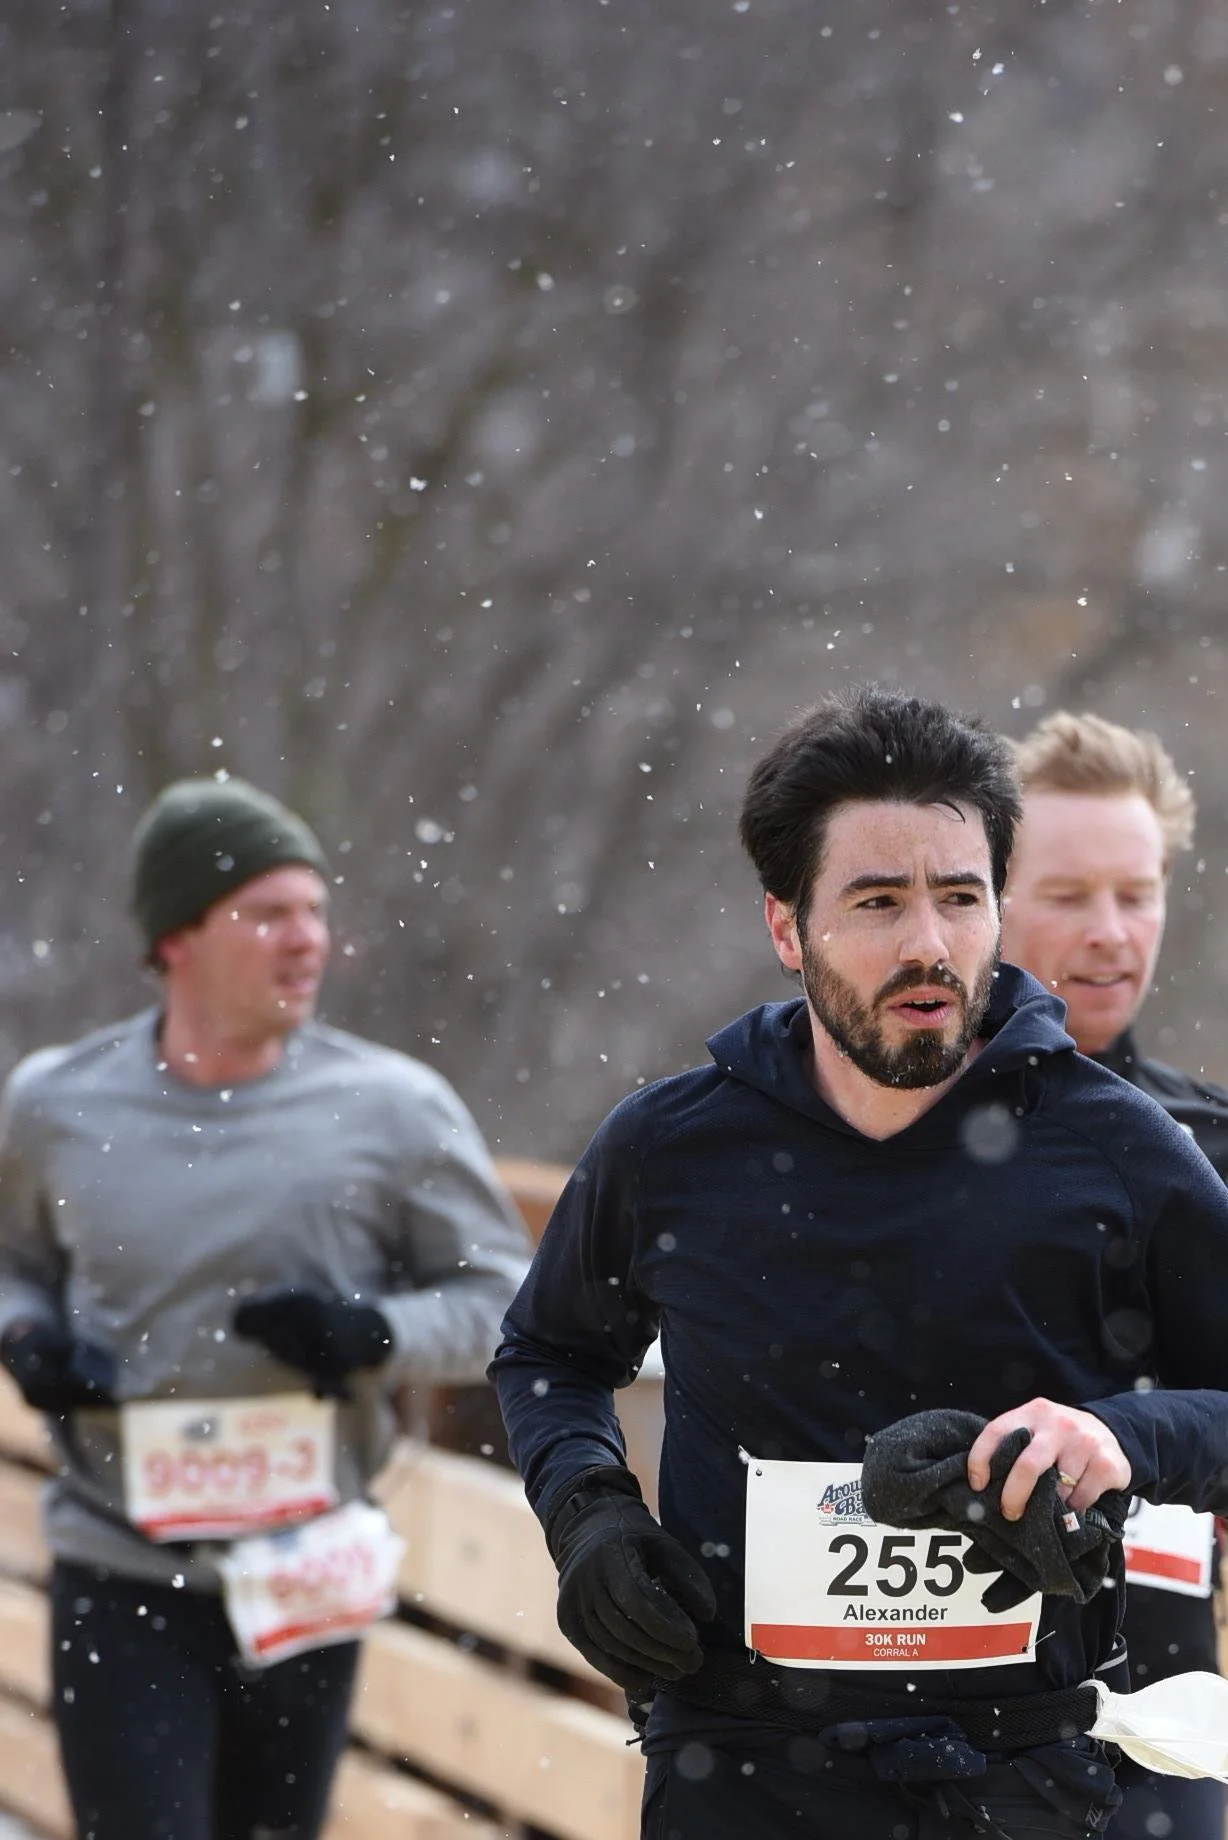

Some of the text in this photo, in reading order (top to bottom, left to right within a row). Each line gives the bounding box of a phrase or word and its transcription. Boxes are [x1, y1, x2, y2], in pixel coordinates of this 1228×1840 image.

[817, 1480, 864, 1506] Arou
[835, 1497, 867, 1516] Ba
[827, 1534, 965, 1598] 255
[843, 1604, 949, 1621] Alexander
[865, 1634, 926, 1646] 30K RUN
[873, 1648, 919, 1657] CORRAL A
